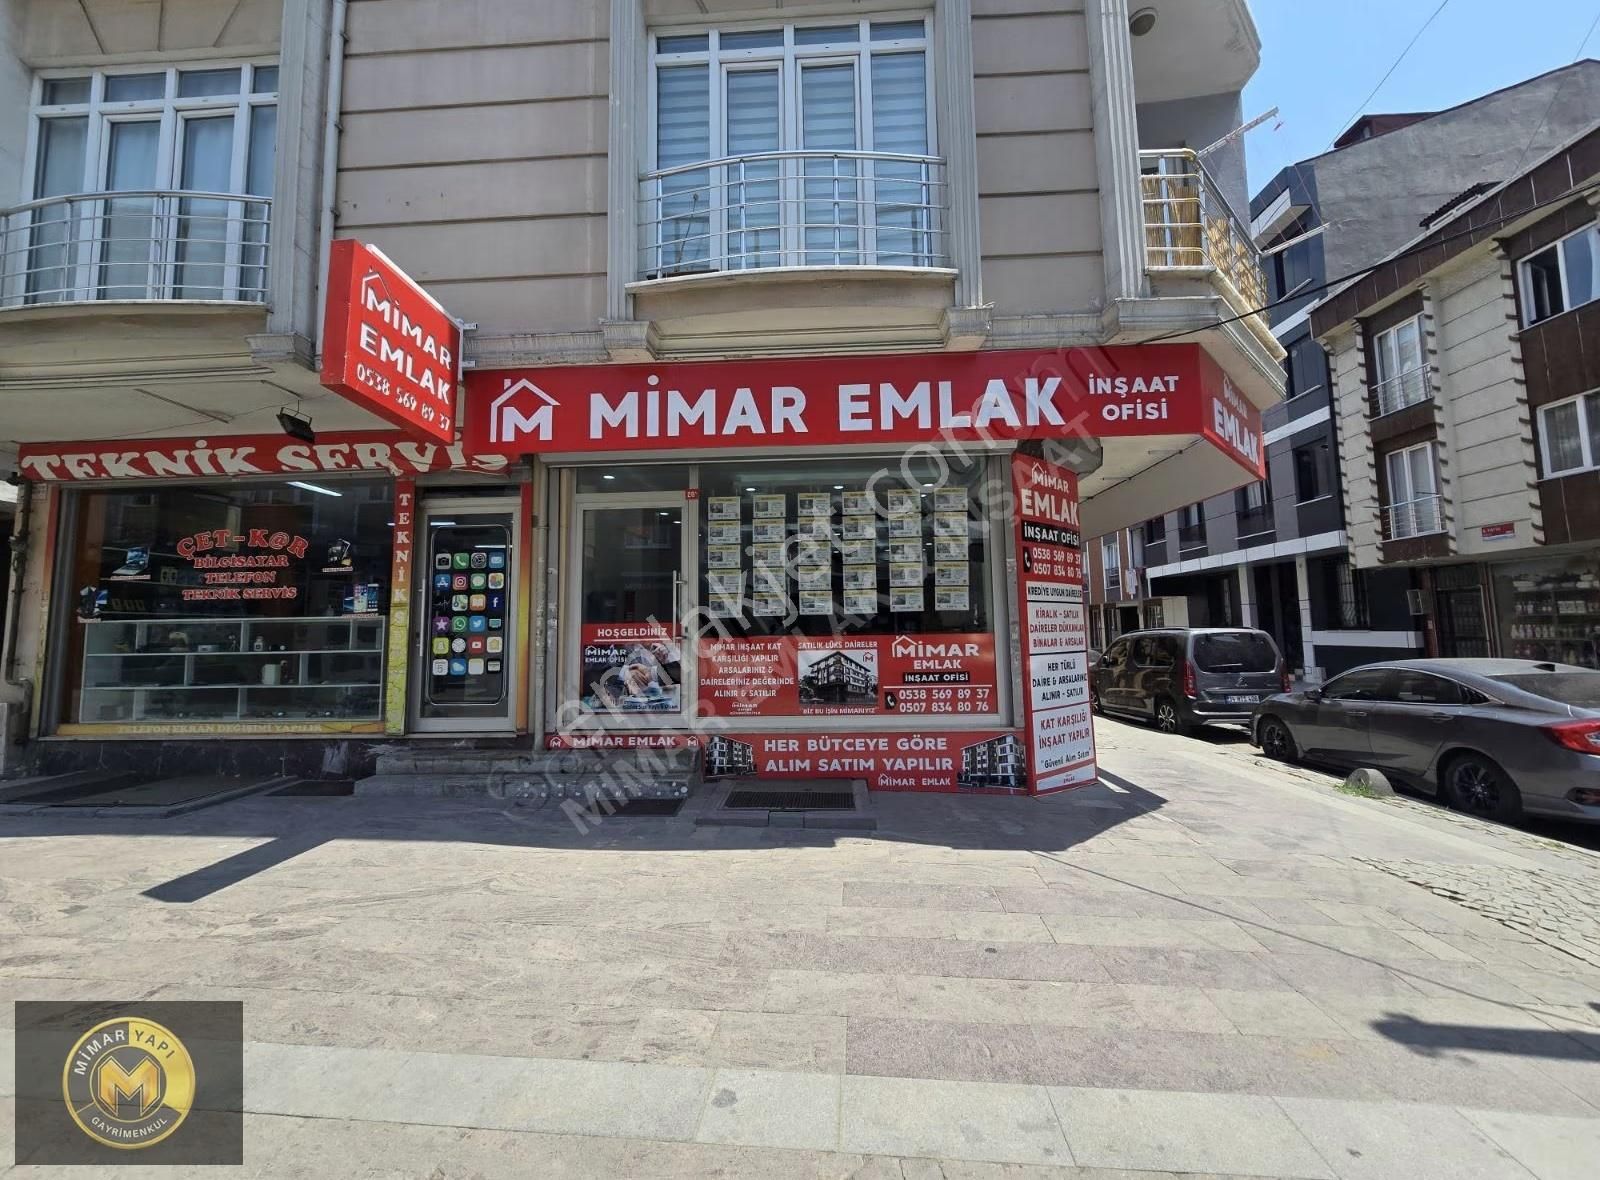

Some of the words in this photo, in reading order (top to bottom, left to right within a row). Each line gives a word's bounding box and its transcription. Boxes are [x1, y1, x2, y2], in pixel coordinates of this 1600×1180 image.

[366, 287, 452, 370] MİMAR
[360, 322, 451, 405] EMLAK
[1088, 373, 1179, 398] İNŞAAT
[357, 363, 390, 396] 0538
[396, 386, 417, 411] 569
[421, 403, 434, 421] 89
[438, 412, 450, 431] 37
[589, 374, 809, 440] MİMAR
[838, 377, 1066, 431] EMLAK
[1102, 398, 1168, 421] OFİSİ
[1213, 397, 1260, 467] EMLAK
[21, 439, 262, 481] TEKNİK
[1032, 470, 1070, 494] MİMAR
[1021, 488, 1080, 527] EMLAK
[1024, 522, 1058, 542] İNŞAAT
[1061, 531, 1080, 546] OFİSİ
[395, 493, 411, 601] TEKNİK
[194, 554, 289, 568] BİLGİSAYAR
[1032, 547, 1051, 559] 0538
[1053, 550, 1065, 562] 569
[1033, 563, 1051, 575] 0507
[1053, 565, 1065, 577] 834
[205, 571, 276, 584] TELEFON
[182, 586, 240, 600] TEKNİK
[243, 586, 297, 599] SERVİS
[1035, 607, 1057, 618] KİRALIK
[597, 626, 668, 639] HOŞGELDİNİZ
[1030, 622, 1057, 633] DAİRELER
[710, 643, 735, 651] MİMAR
[737, 642, 764, 652] İNŞAAT
[767, 642, 782, 650] KAT
[825, 640, 843, 648] LÜKS
[844, 640, 878, 648] DAİRELER
[1033, 637, 1057, 647] BİNALAR
[896, 641, 980, 657] MİMAR
[712, 654, 748, 664] KARŞILIĞI
[751, 654, 778, 662] YAPILIR
[913, 660, 961, 669] EMLAK
[1047, 662, 1058, 672] HER
[1060, 659, 1076, 671] TÜRLÜ
[718, 666, 766, 674] ARSALARINIZ
[700, 677, 750, 686] DAİRELERİNİZ
[752, 676, 794, 685] DEĞERİNDE
[905, 674, 940, 683] İNŞAAT
[943, 672, 969, 681] OFİSİ
[1032, 676, 1051, 688] DAİRE
[714, 689, 738, 697] ALINIR
[749, 689, 777, 697] SATILIR
[899, 690, 927, 699] 0538
[932, 689, 952, 699] 569
[957, 689, 971, 698] 89
[976, 688, 990, 698] 37
[1041, 690, 1060, 701] ALINIR
[900, 702, 926, 712] 0507
[932, 702, 952, 711] 834
[958, 702, 971, 711] 80
[976, 701, 989, 711] 76
[1041, 718, 1056, 731] KAT
[573, 736, 625, 747] MİMAR
[628, 736, 676, 746] EMLAK
[764, 739, 799, 752] HER
[807, 736, 889, 751] BÜTCEYE
[896, 734, 947, 750] GÖRE
[1039, 733, 1066, 750] İNŞAAT
[1068, 727, 1090, 741] YAPILIR
[765, 759, 811, 772] ALIM
[818, 758, 875, 771] SATIM
[882, 758, 952, 770] YAPILIR
[880, 775, 916, 786] MİMAR
[922, 777, 951, 786] EMLAK
